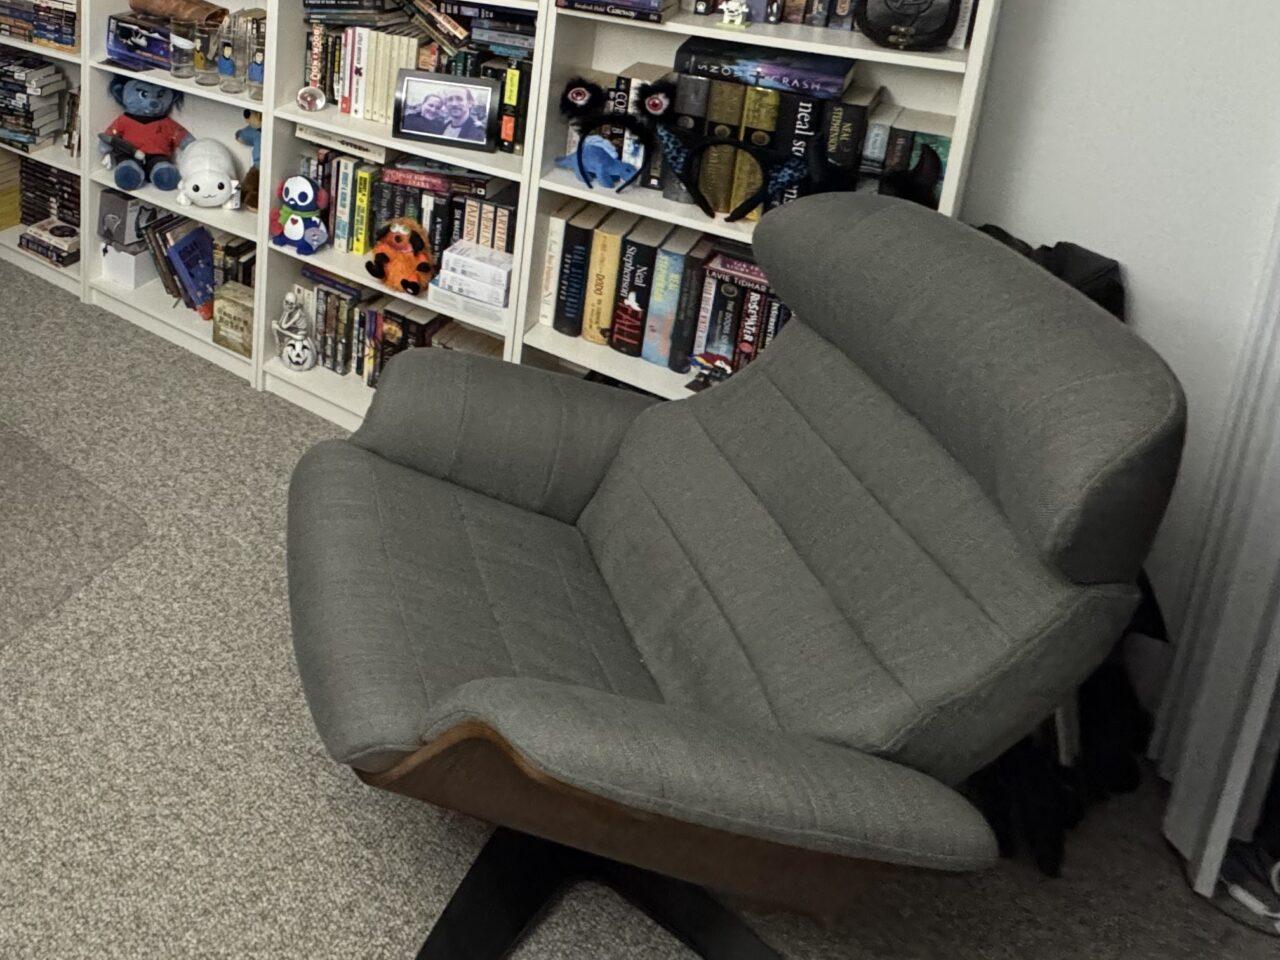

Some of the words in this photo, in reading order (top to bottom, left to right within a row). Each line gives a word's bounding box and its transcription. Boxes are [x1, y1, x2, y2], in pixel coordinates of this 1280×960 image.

[766, 72, 821, 91] CRASH
[794, 100, 818, 136] neal
[825, 106, 843, 153] STEPHENSON
[839, 120, 852, 141] NEAL
[617, 244, 638, 298] Stephenson
[632, 264, 648, 287] Neal
[704, 269, 731, 282] LAVIE
[732, 277, 767, 292] TIDHAR
